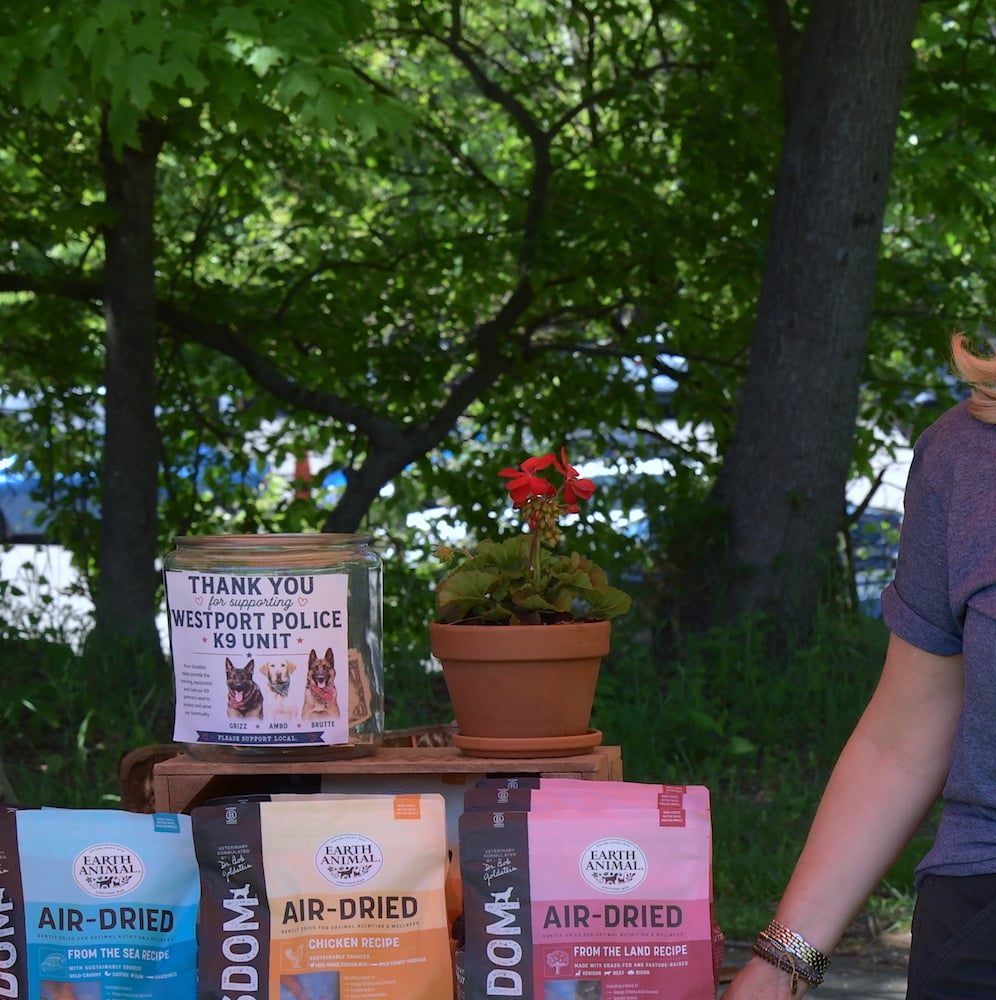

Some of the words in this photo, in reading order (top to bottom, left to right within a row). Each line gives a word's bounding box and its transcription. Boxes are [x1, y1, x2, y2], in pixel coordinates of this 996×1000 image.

[188, 576, 262, 595] THANK
[270, 576, 314, 595] YOU
[208, 596, 226, 610] for
[230, 596, 294, 612] supporting
[172, 610, 264, 630] WESTPORT
[272, 610, 342, 630] POLICE
[214, 632, 236, 649] K9
[242, 633, 292, 649] UNIT
[325, 844, 372, 856] EARTH
[591, 850, 635, 861] EARTH
[83, 855, 132, 866] EARTH
[320, 854, 377, 865] ANIMAL
[586, 861, 641, 870] ANIMAL
[78, 864, 138, 876] ANIMAL
[282, 896, 418, 925] AIR-DRIED
[543, 904, 683, 929] AIR-DRIED
[38, 906, 174, 932] AIR-DRIED
[309, 937, 358, 950] CHICKEN
[362, 937, 400, 948] RECIPE
[68, 949, 97, 960] FROM
[100, 948, 120, 959] THE
[123, 948, 140, 960] SEA
[141, 949, 170, 961] RECIPE
[574, 946, 600, 957] FROM
[603, 946, 621, 956] THE
[624, 945, 650, 956] LAND
[654, 945, 687, 956] RECIPE
